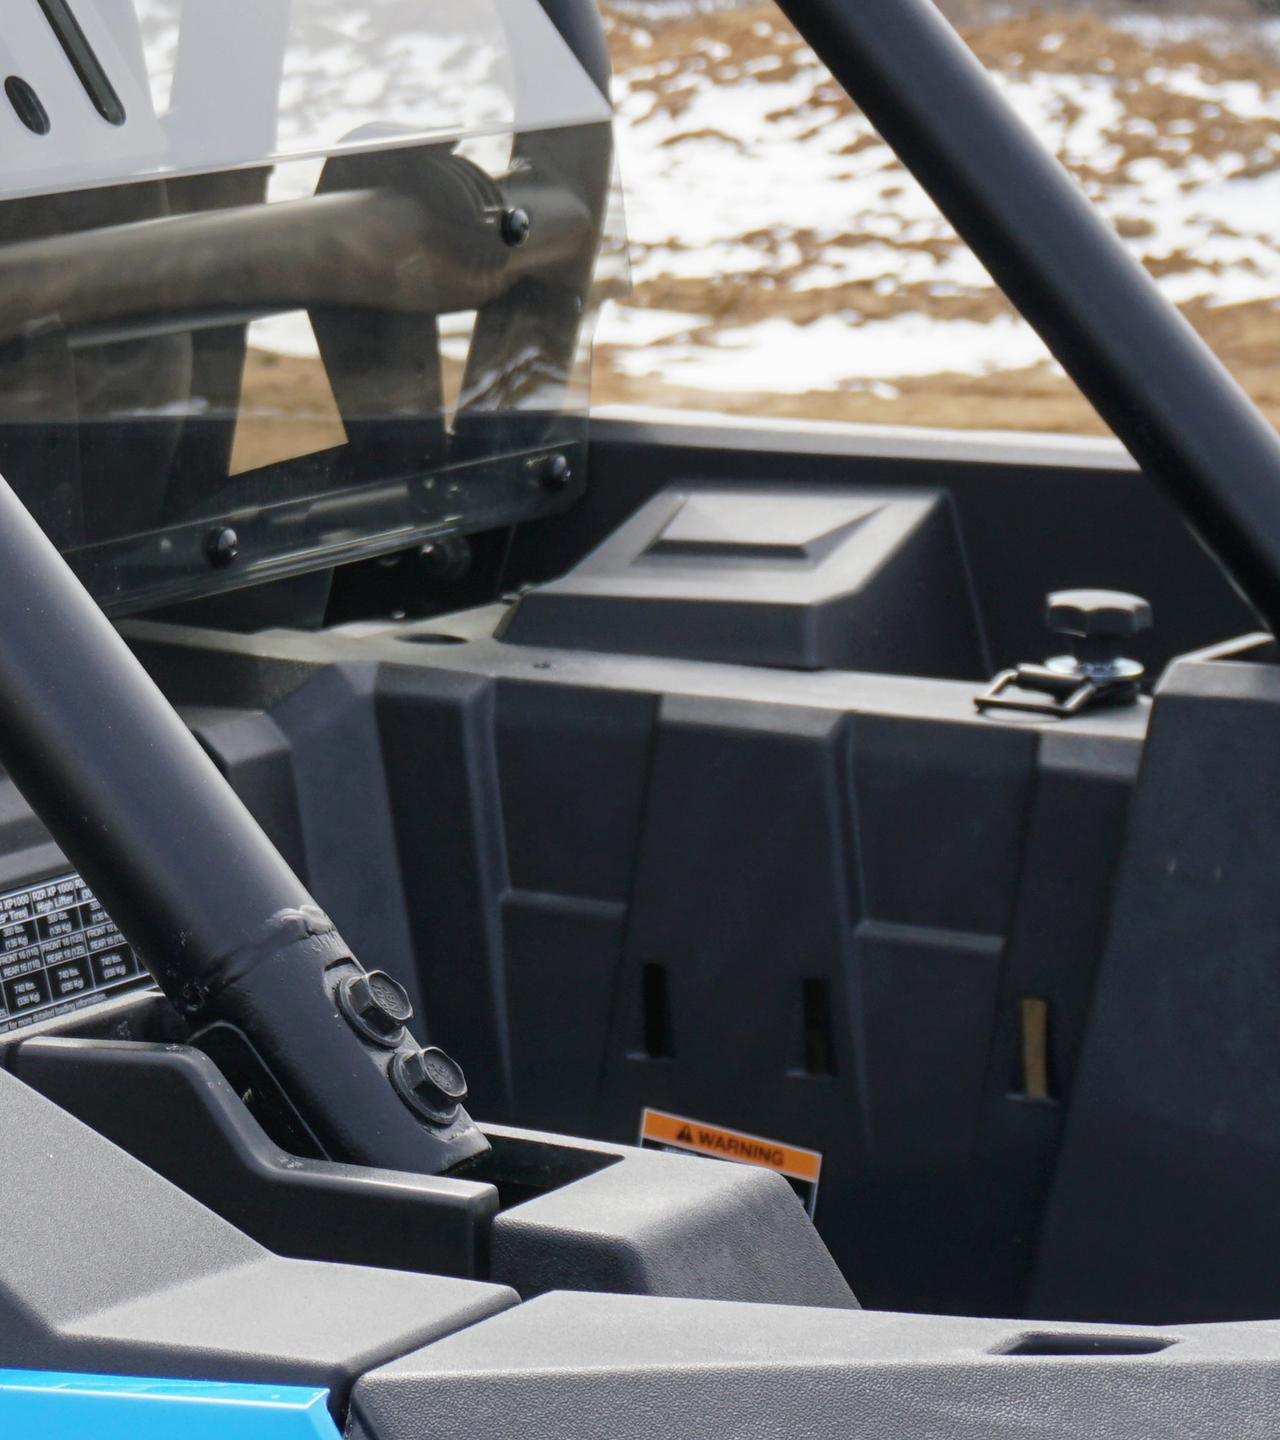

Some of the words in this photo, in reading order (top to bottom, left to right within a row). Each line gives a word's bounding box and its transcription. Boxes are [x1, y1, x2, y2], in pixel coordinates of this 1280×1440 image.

[32, 889, 46, 902] RZR
[46, 886, 57, 898] XP
[58, 881, 74, 894] 1000
[4, 894, 30, 910] XP1000
[36, 899, 53, 913] High
[54, 894, 74, 908] Lifter
[9, 907, 28, 922] Tires)
[47, 914, 58, 924] 300
[58, 911, 69, 922] lbs.
[3, 927, 14, 937] 300
[15, 924, 25, 935] lbs.
[61, 922, 72, 934] Kg)
[87, 926, 105, 939] FRONT
[17, 935, 28, 948] Kg)
[42, 940, 62, 953] FRONT
[90, 939, 107, 951] REAR
[46, 952, 63, 964] REAR
[111, 953, 122, 964] lbs.
[3, 966, 20, 978] REAR
[69, 966, 80, 977] lbs.
[25, 980, 36, 991] lbs.
[73, 978, 84, 990] Kg)
[29, 992, 40, 1004] Kg)
[9, 1020, 17, 1030] for
[18, 1016, 33, 1028] more
[33, 1008, 55, 1023] detailed
[697, 1130, 784, 1167] WARNING
